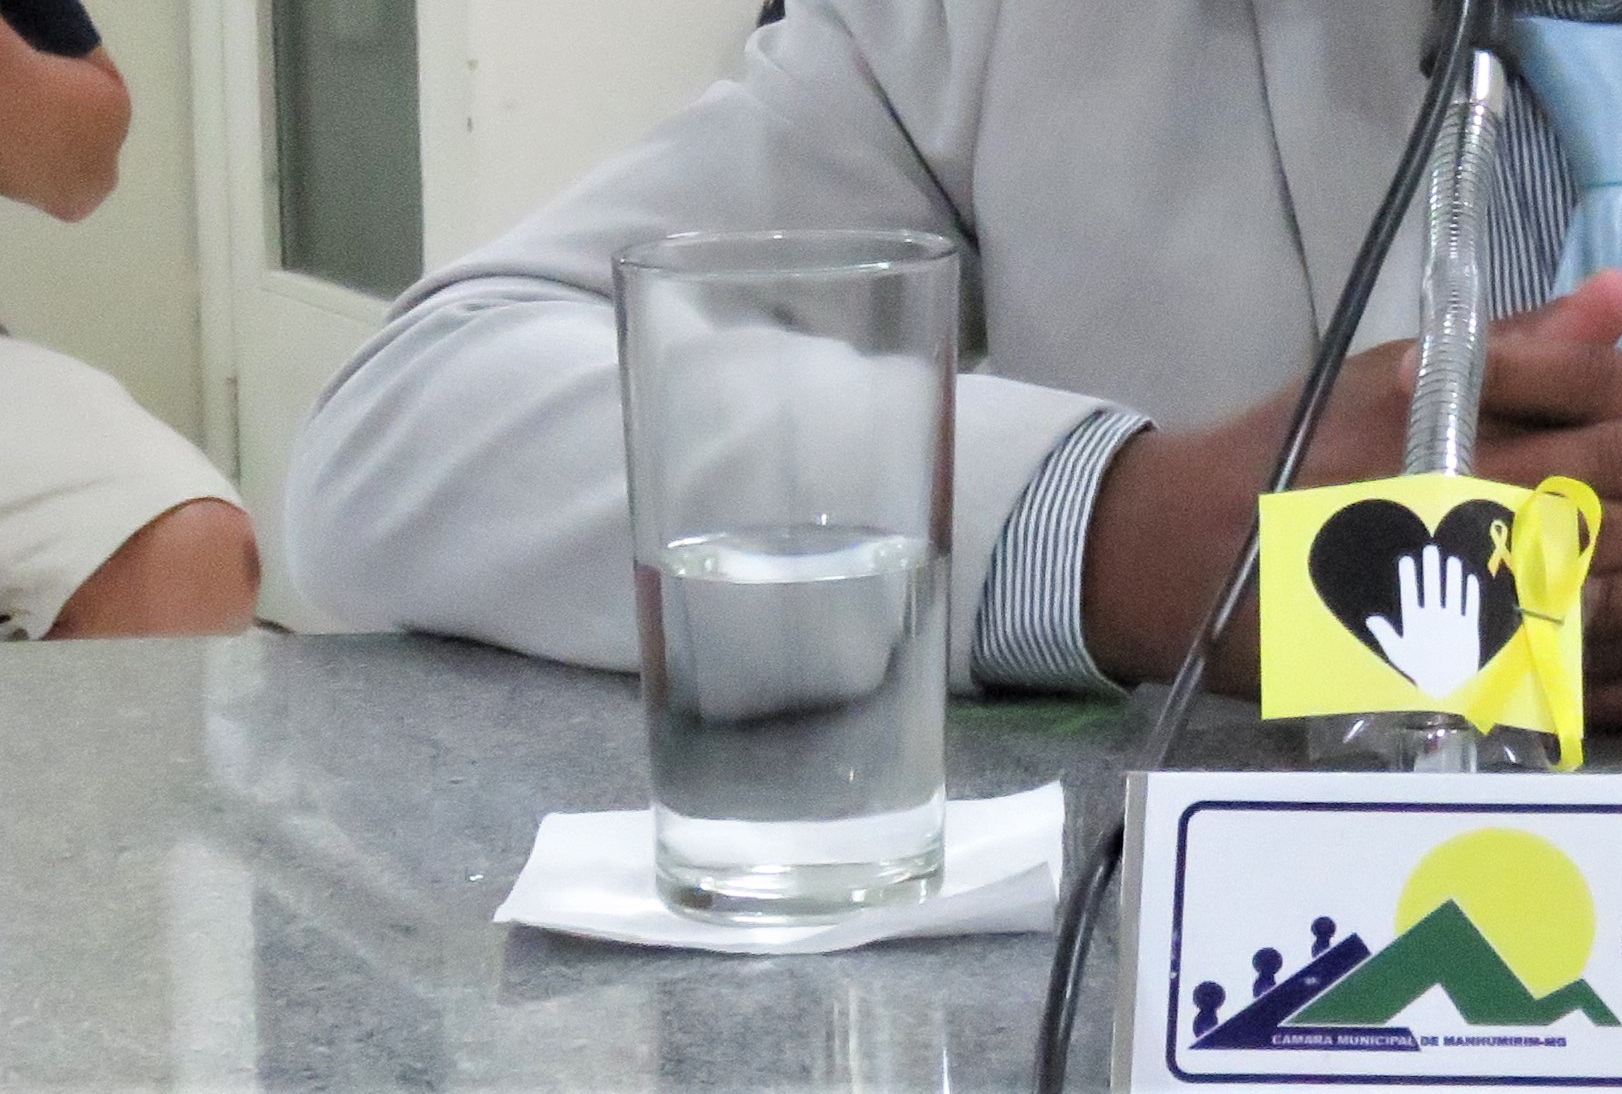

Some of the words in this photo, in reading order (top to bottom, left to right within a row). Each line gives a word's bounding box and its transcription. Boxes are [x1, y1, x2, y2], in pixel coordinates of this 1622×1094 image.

[1336, 1035, 1416, 1047] MUNICIPAL
[1420, 1036, 1439, 1046] DE
[1443, 1036, 1567, 1047] MANHUMIRIM-MG
